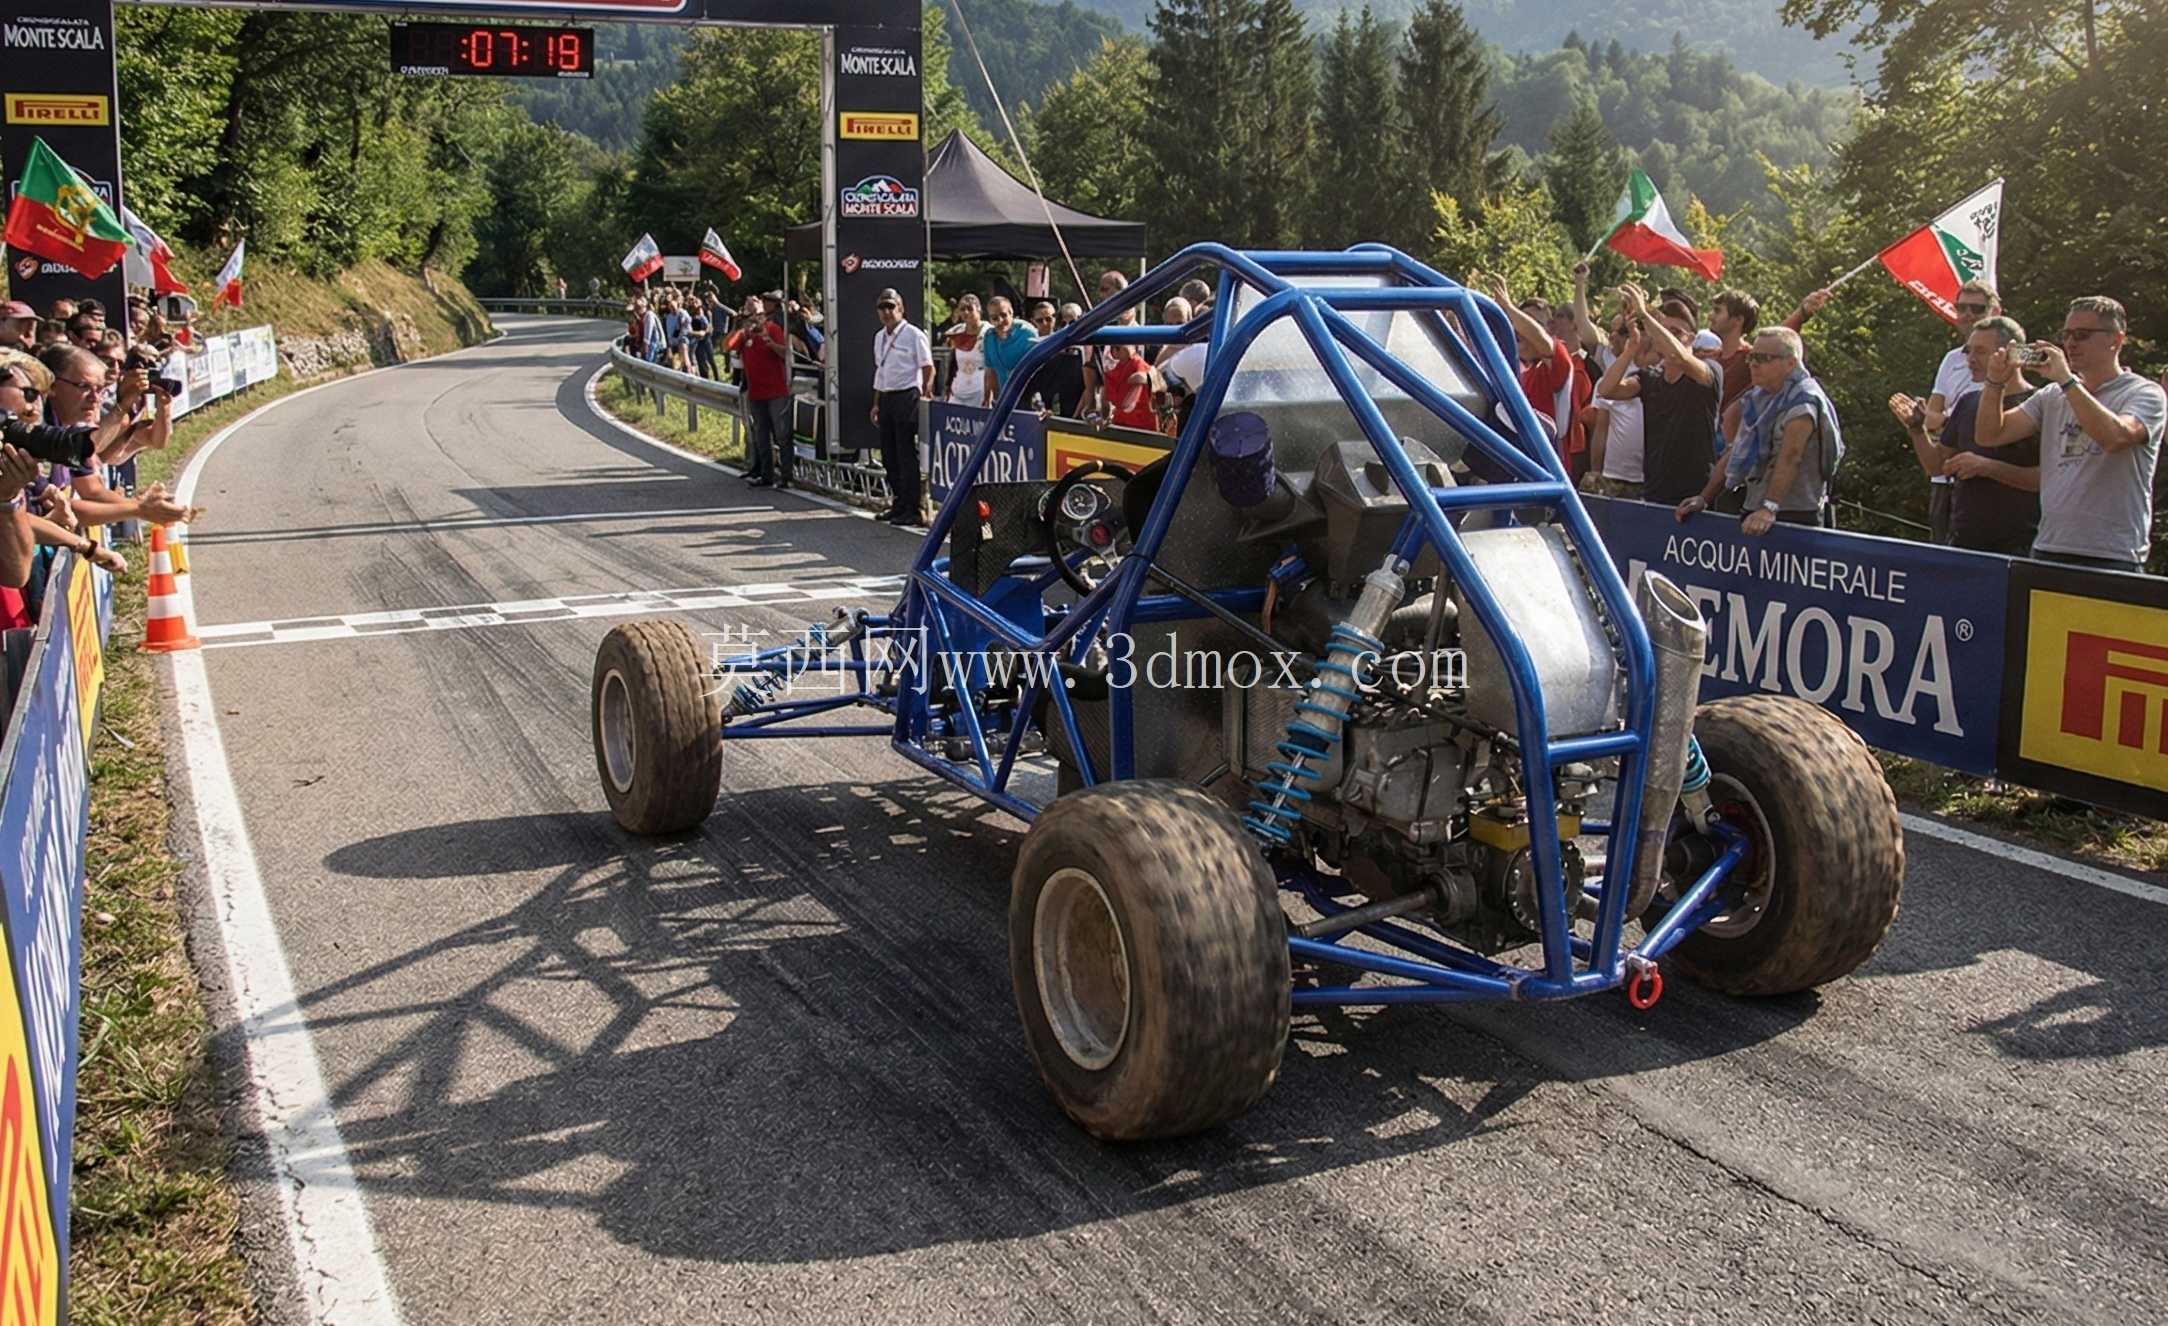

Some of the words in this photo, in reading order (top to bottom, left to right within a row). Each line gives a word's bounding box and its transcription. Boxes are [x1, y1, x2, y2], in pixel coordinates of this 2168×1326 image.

[4, 23, 56, 48] MONTE
[57, 26, 104, 50] SCALA
[841, 53, 880, 75] MONTE
[881, 55, 917, 77] SCALA
[15, 100, 100, 120] PIRELLI
[847, 117, 912, 135] PIRELLI
[1663, 535, 1752, 576] ACQUA
[1759, 550, 1907, 604] MINERALE
